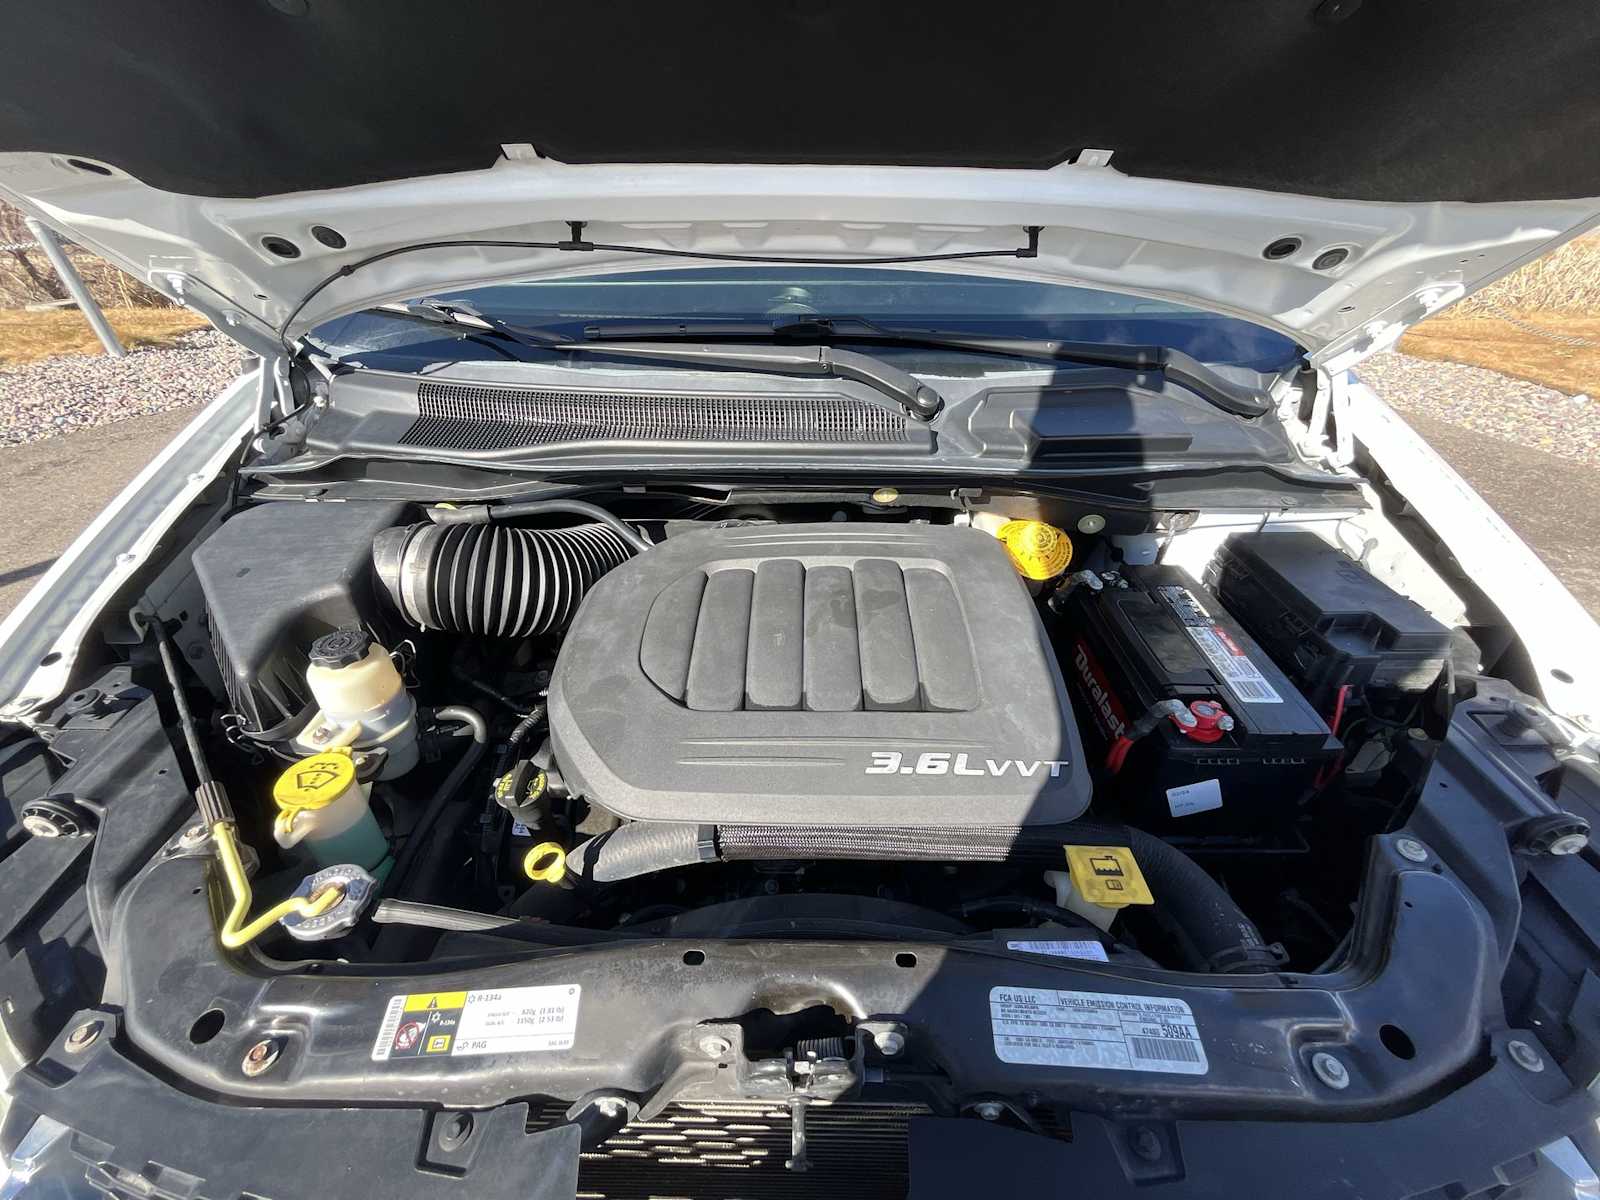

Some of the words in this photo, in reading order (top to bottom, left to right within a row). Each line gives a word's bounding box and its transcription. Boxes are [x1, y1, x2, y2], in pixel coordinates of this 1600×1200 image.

[1074, 644, 1126, 739] Duralast
[477, 993, 503, 1002] R-134a
[999, 993, 1012, 1002] FCA
[1013, 994, 1023, 1003] US
[1024, 995, 1037, 1004] LLC
[1060, 998, 1084, 1007] VEHICLE
[1086, 1000, 1115, 1009] EMISSION
[1116, 1001, 1142, 1010] CONTROL
[1143, 1003, 1184, 1013] INFORMATION
[471, 1040, 488, 1050] PAG
